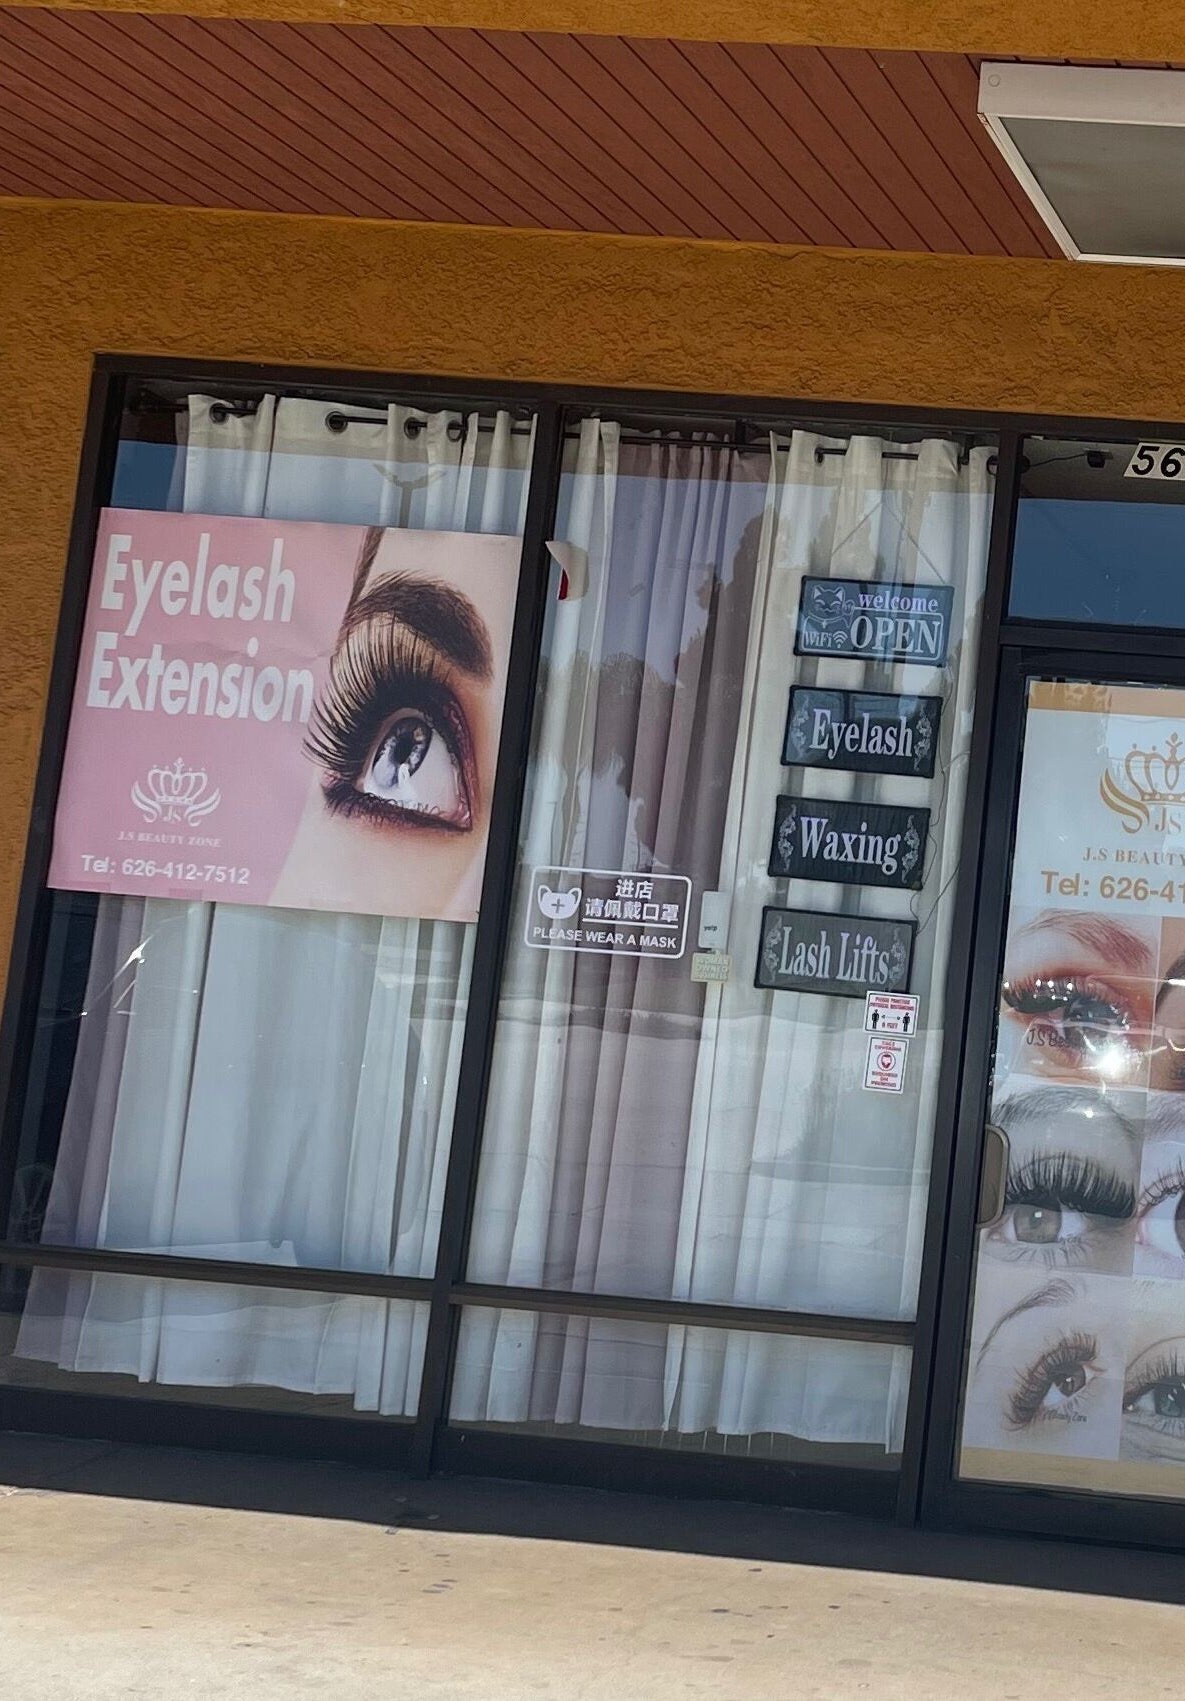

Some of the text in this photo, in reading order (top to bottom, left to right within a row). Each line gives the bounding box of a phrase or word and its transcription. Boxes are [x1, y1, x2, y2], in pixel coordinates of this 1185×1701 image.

[99, 532, 297, 637] Eyelash
[858, 590, 939, 613] welcome
[803, 630, 833, 648] WiFi
[850, 615, 941, 654] OPEN
[85, 630, 316, 725] Extension
[808, 708, 913, 760] Eyelash
[137, 832, 184, 845] BEAUTY
[188, 835, 222, 848] ZONE
[800, 815, 902, 876] Waxing
[1082, 847, 1108, 862] J.S
[80, 854, 250, 885] Tel: 626-412-7512
[615, 879, 654, 900] 进店
[1040, 870, 1090, 897] Tel:
[585, 897, 680, 923] 请佩戴口罩
[532, 926, 677, 949] PLEASE WEAR A MASK
[778, 926, 890, 985] Lash Lifts
